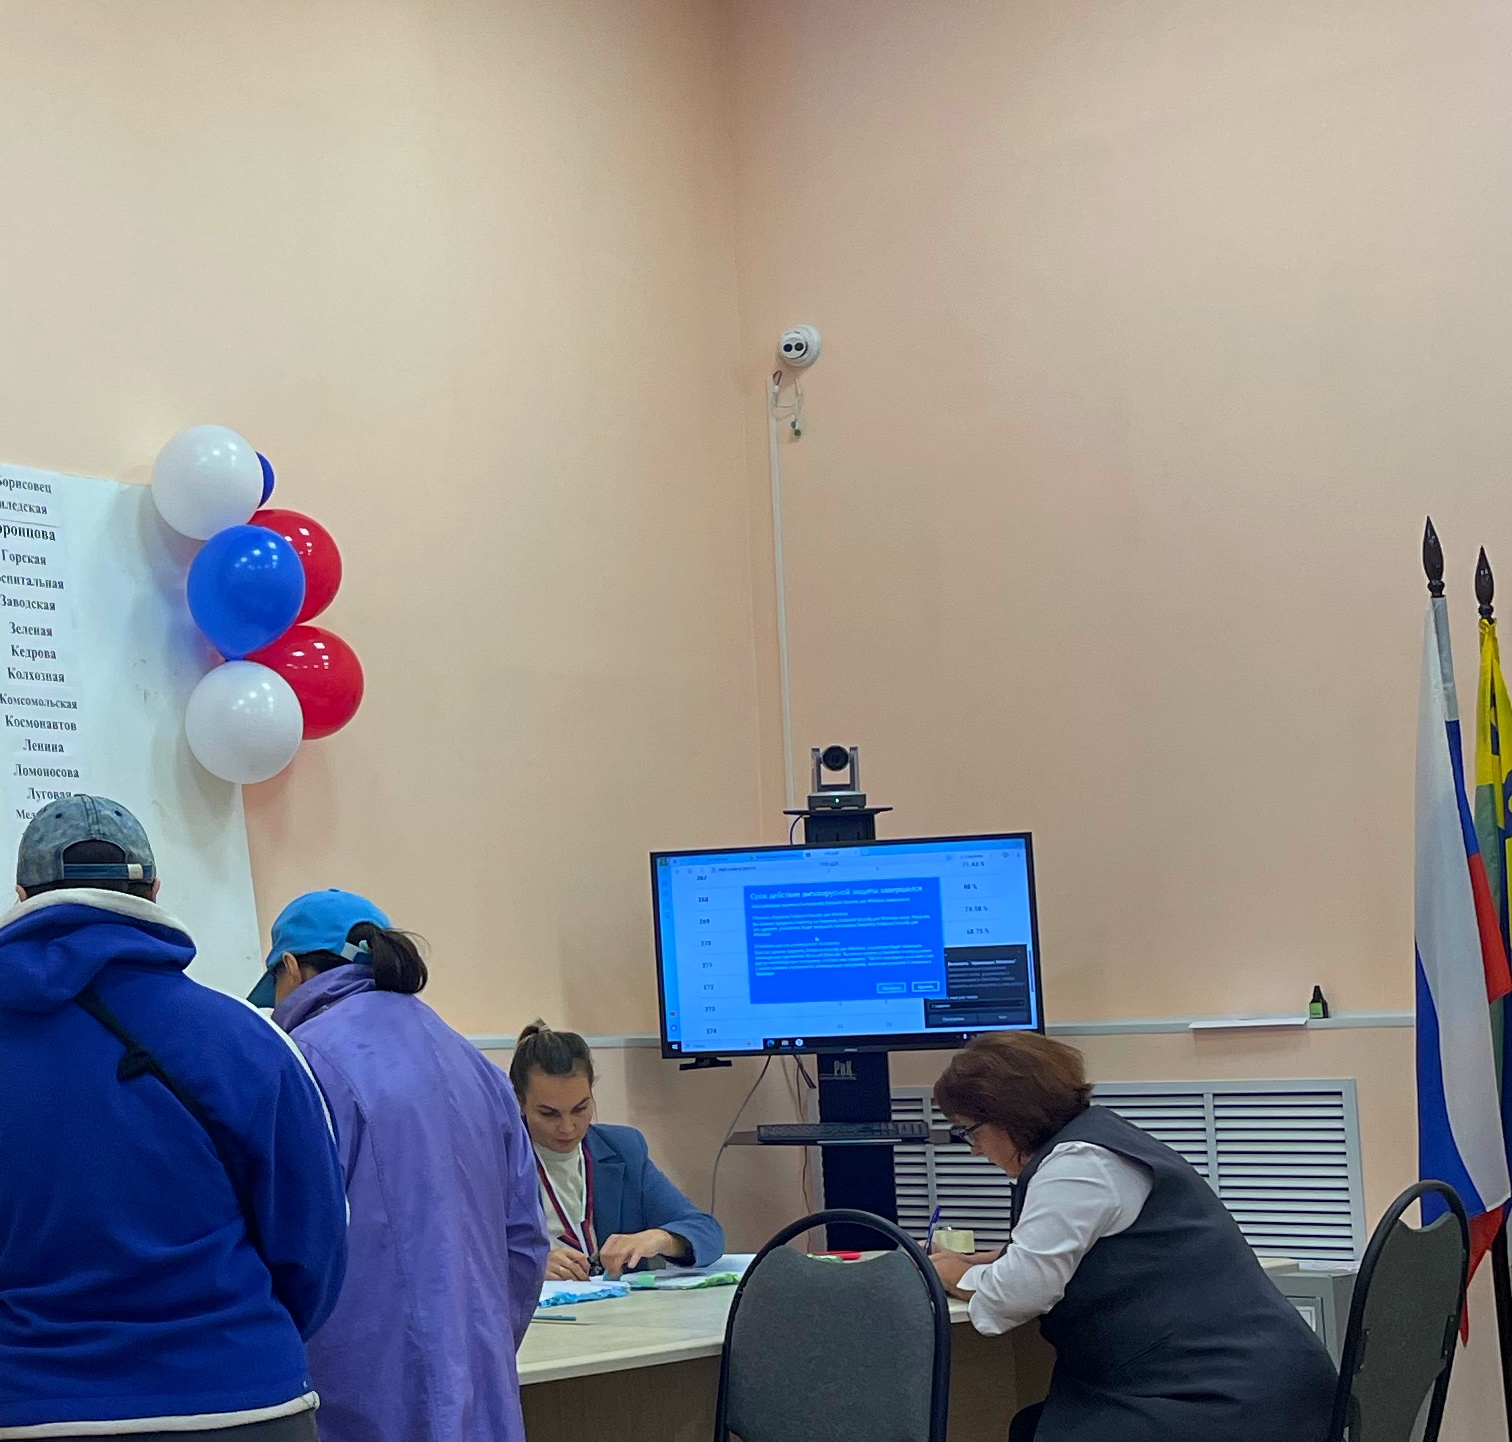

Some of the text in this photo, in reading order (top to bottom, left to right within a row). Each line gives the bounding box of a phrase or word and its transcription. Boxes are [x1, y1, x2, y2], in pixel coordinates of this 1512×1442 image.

[1, 549, 47, 566] Горская
[0, 594, 56, 611] Заводская
[9, 621, 53, 637] Зеленая
[11, 644, 57, 662] Кедрова
[7, 666, 65, 683] Колхозная
[0, 692, 78, 710] Комсомольская
[5, 714, 77, 731] Космонавтов
[22, 738, 65, 753] Ленина
[13, 763, 80, 778] Ломоносова
[26, 787, 72, 803] Луговая
